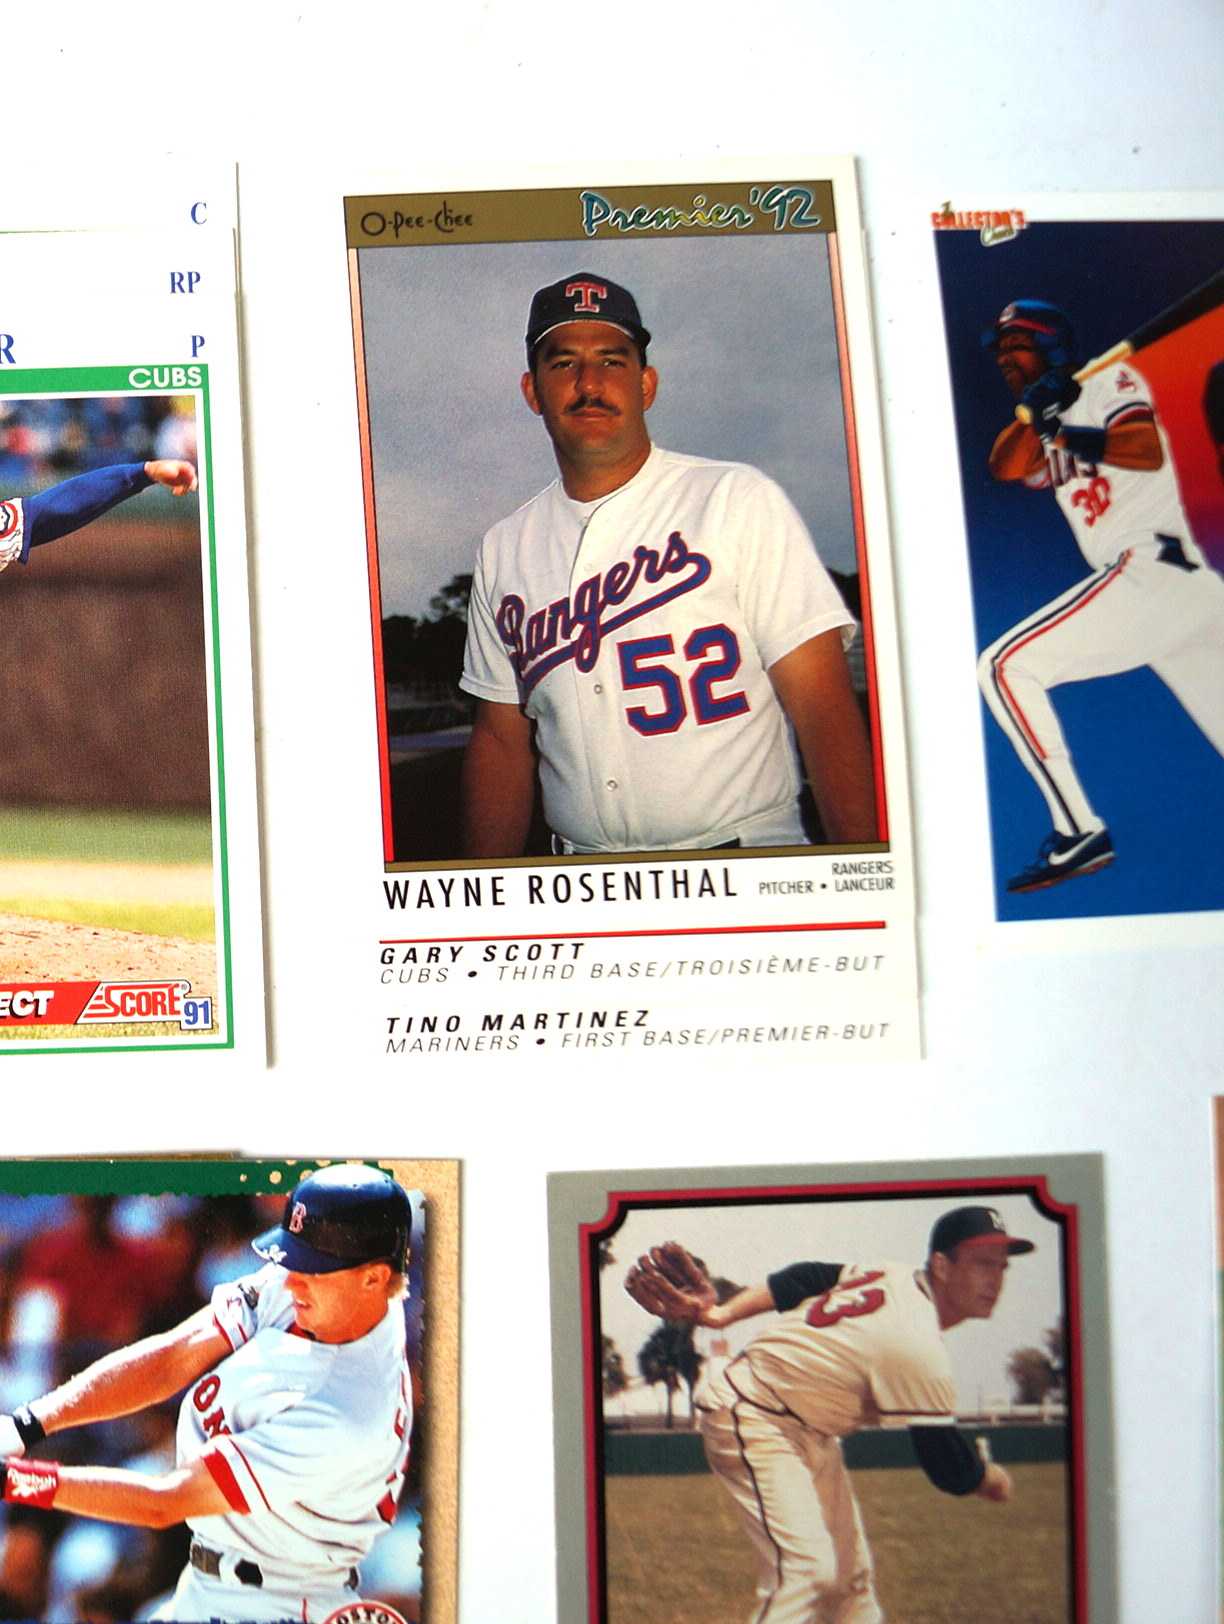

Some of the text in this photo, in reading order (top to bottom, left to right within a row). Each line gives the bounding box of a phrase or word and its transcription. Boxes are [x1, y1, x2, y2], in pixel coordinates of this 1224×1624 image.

[190, 202, 207, 225] C
[169, 271, 201, 294] RP
[565, 281, 607, 313] T
[191, 335, 205, 358] P
[128, 367, 202, 388] CUBS
[496, 531, 706, 678] Rangers
[616, 623, 751, 737] 52
[831, 860, 894, 876] RANGERS
[383, 867, 738, 910] WAYNE ROSENTHAL
[759, 877, 895, 895] PITCHER LANCEUR
[380, 942, 585, 965] GARY SCOTT
[380, 967, 449, 984] CUBS
[497, 964, 575, 981] THIRD
[82, 983, 210, 1025] SCORE 91
[386, 1010, 649, 1034] TINO MARTINEZ
[386, 1034, 520, 1053] MARINERS
[561, 1031, 632, 1049] FIRST
